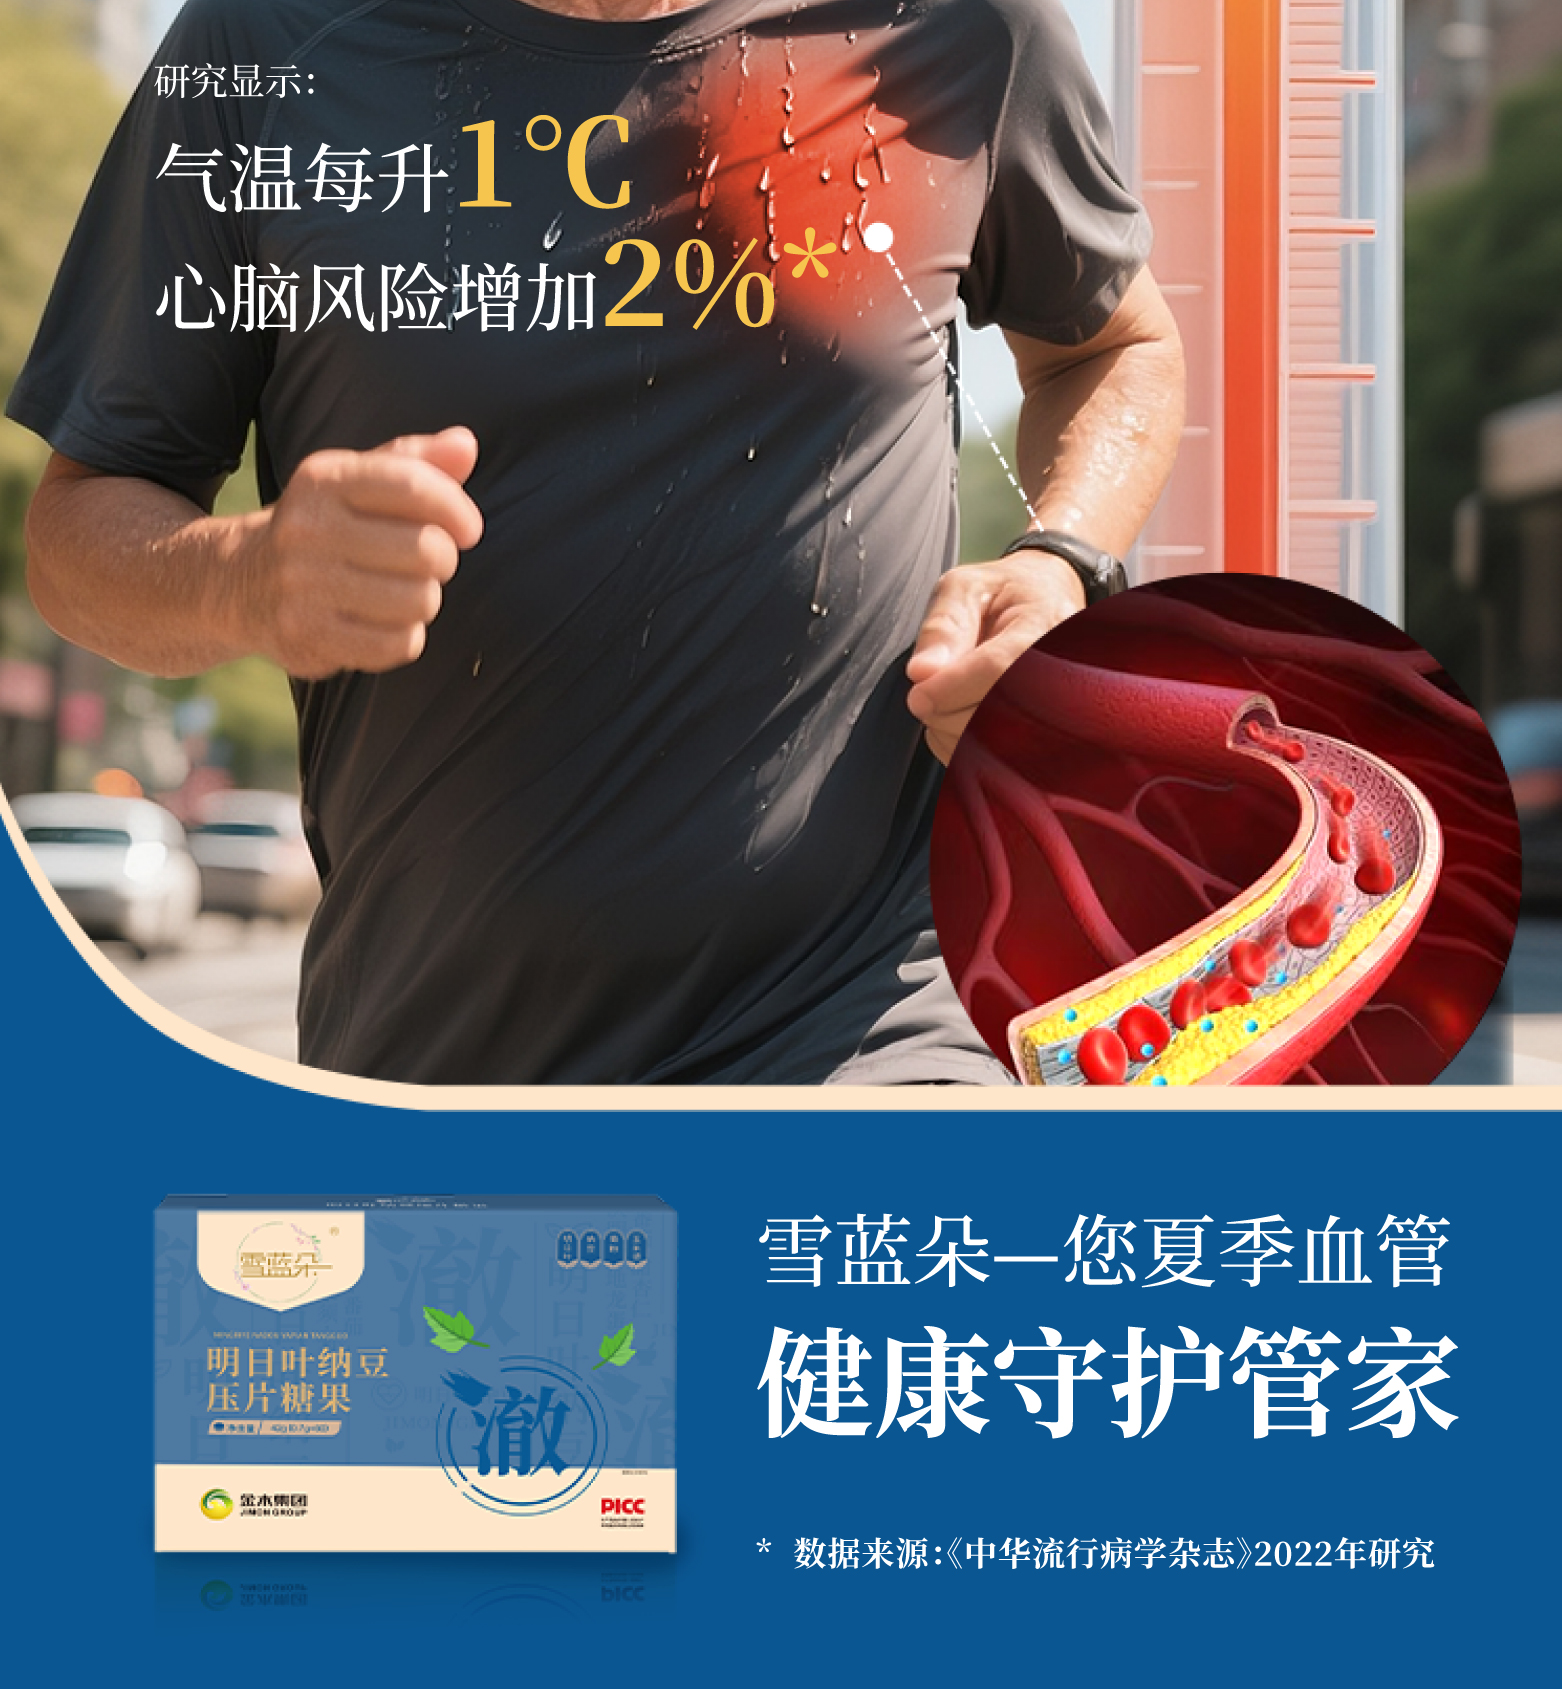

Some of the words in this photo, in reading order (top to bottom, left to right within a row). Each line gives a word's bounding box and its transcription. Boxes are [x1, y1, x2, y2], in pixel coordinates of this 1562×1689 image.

[240, 1251, 334, 1279] 雪蓝朵
[207, 1346, 389, 1378] 明日叶纳豆
[207, 1381, 351, 1414] 压片糖果
[756, 1325, 1460, 1439] 健康守护管家
[600, 1497, 646, 1515] PICC
